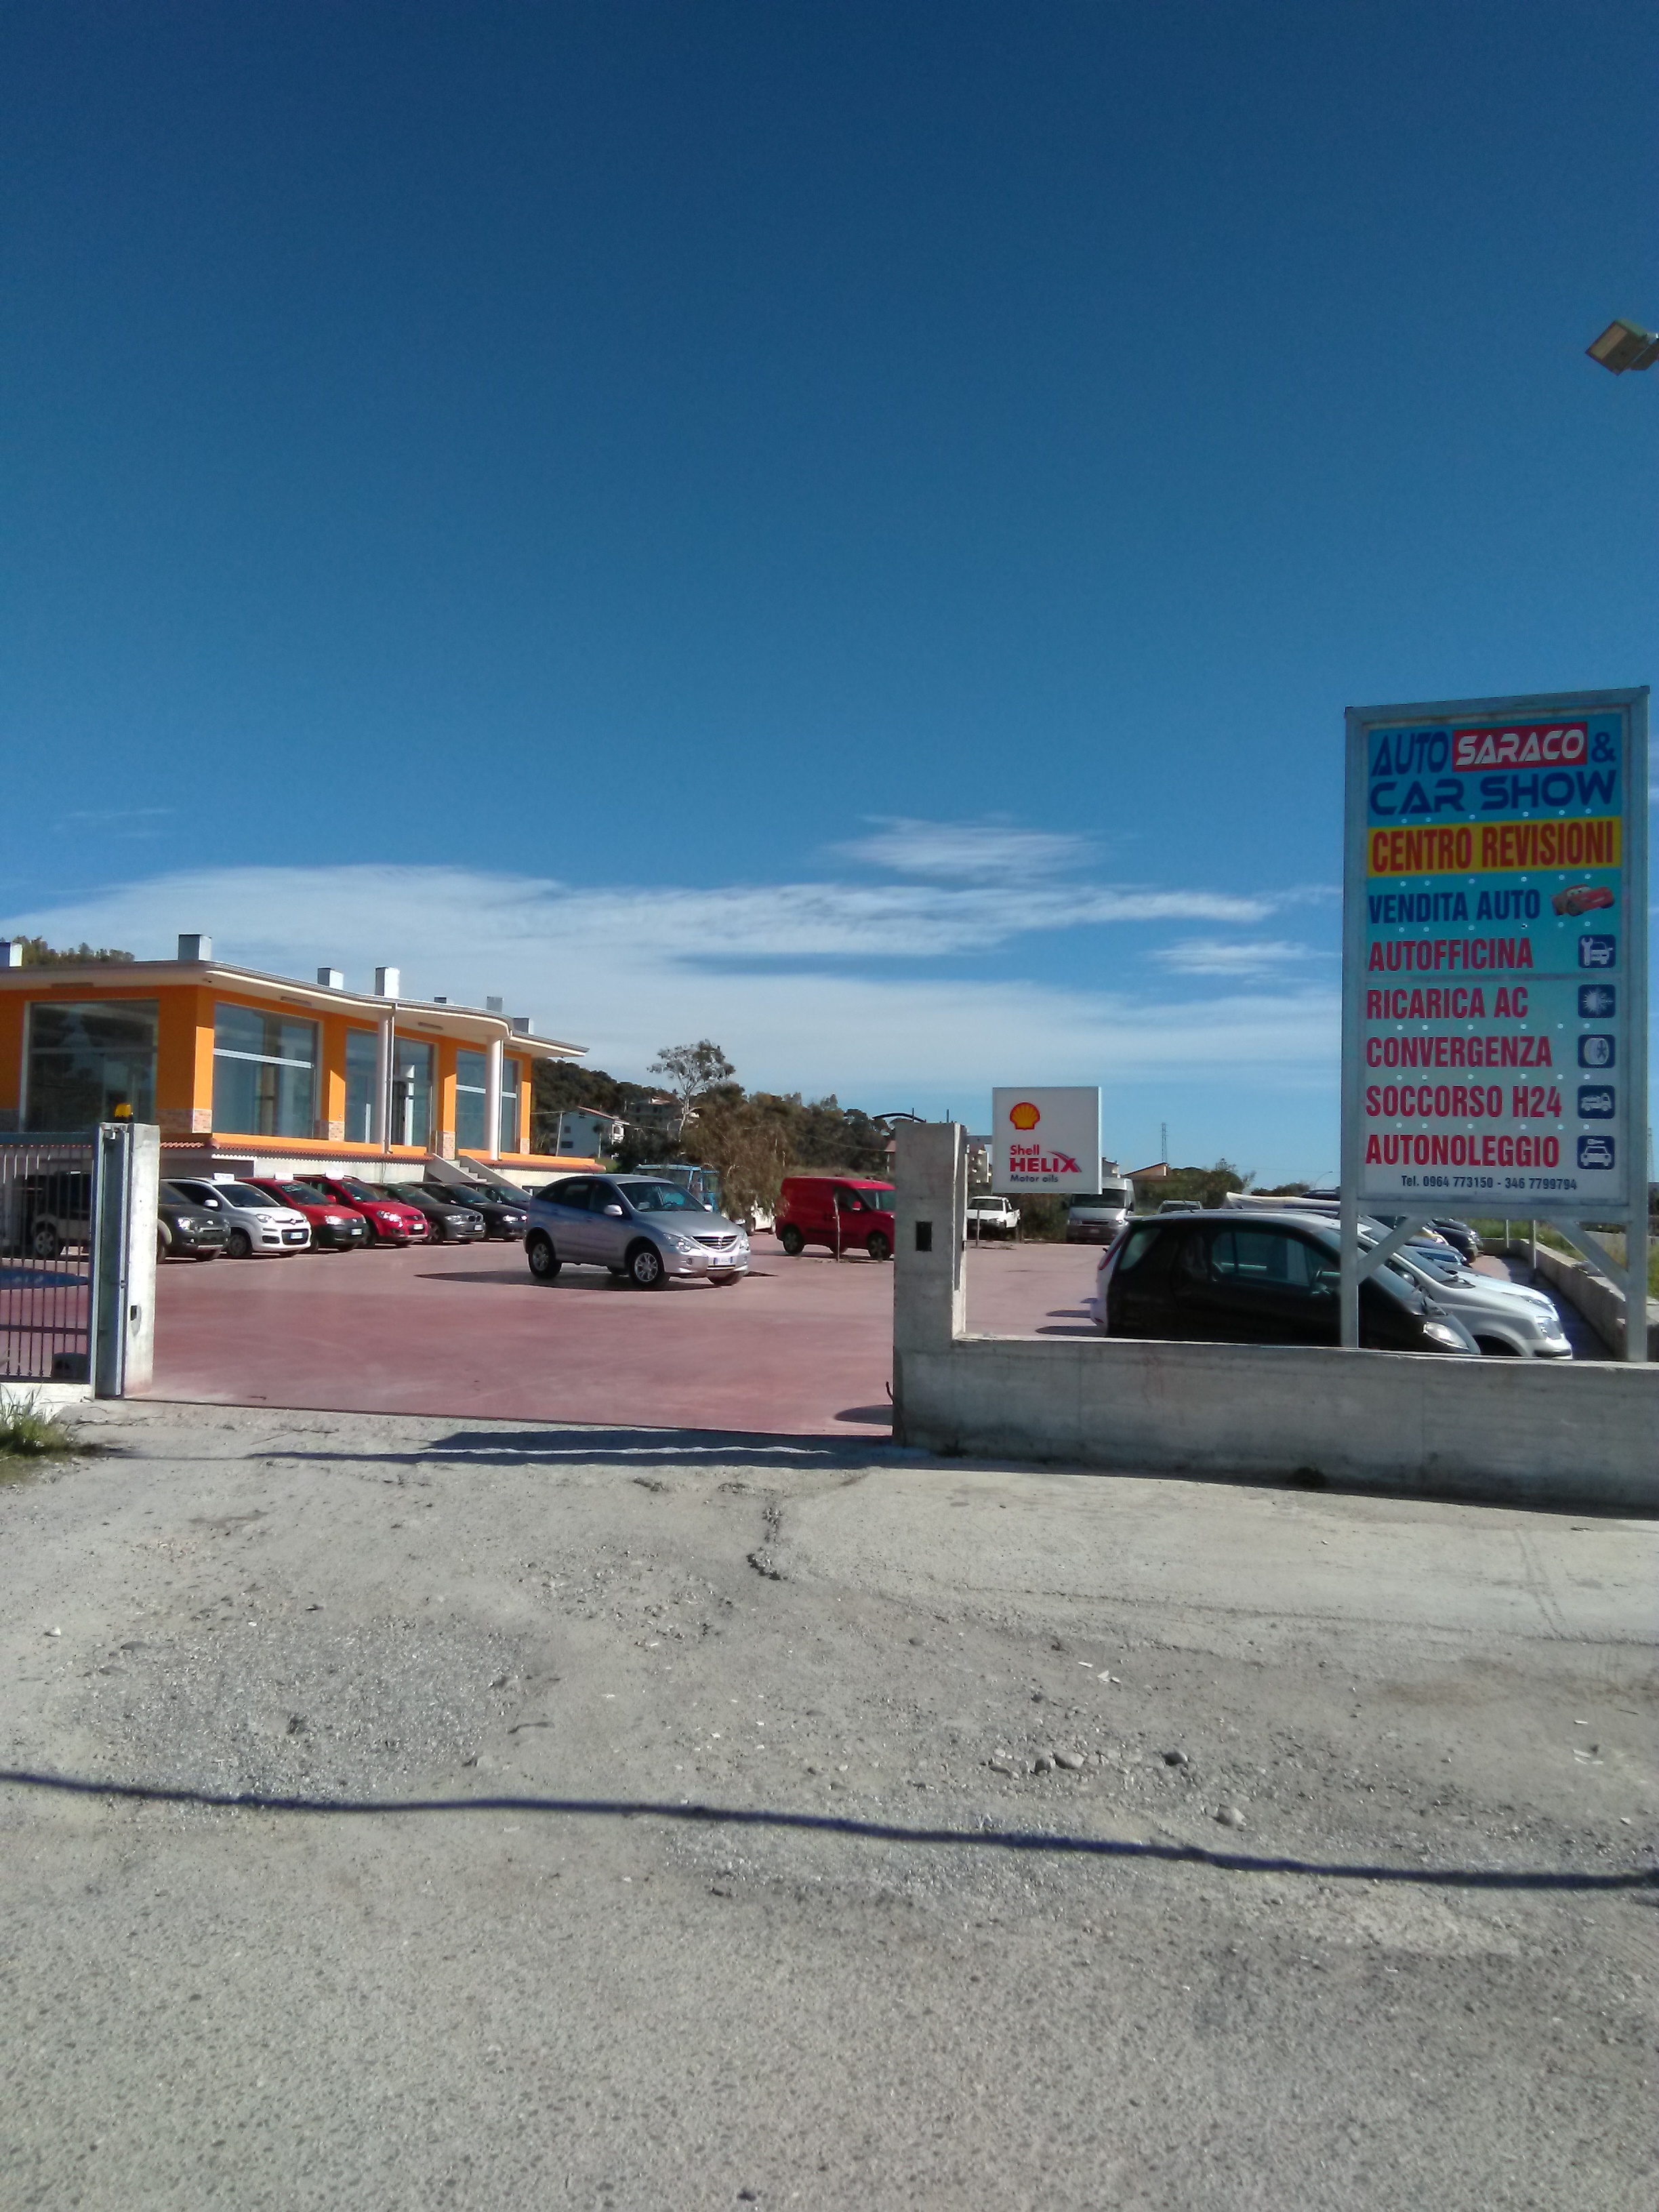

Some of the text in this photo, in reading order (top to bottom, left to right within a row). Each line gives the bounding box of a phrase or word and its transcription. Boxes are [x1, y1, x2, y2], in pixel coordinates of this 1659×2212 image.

[1371, 729, 1616, 777] AUTO SARACO &
[1370, 770, 1616, 815] CAR SHOW
[1372, 821, 1614, 872] CENTRO REVISIONI
[1369, 888, 1540, 924] VENDITA AUTO
[1368, 938, 1534, 971] AUTOFFICINA
[1367, 987, 1528, 1019] RICARICA AC
[1366, 1036, 1552, 1068] CONVERGENZA
[1366, 1085, 1562, 1118] SOCCORSO H24
[1009, 1158, 1081, 1172] HELIX
[1010, 1144, 1040, 1155] Shell
[1366, 1134, 1559, 1168] AUTONOLEGGIO
[1042, 1174, 1059, 1183] oils
[1401, 1175, 1419, 1187] Tel.
[1423, 1176, 1449, 1187] 0964
[1453, 1176, 1493, 1188] 773150
[1504, 1177, 1525, 1189] 346
